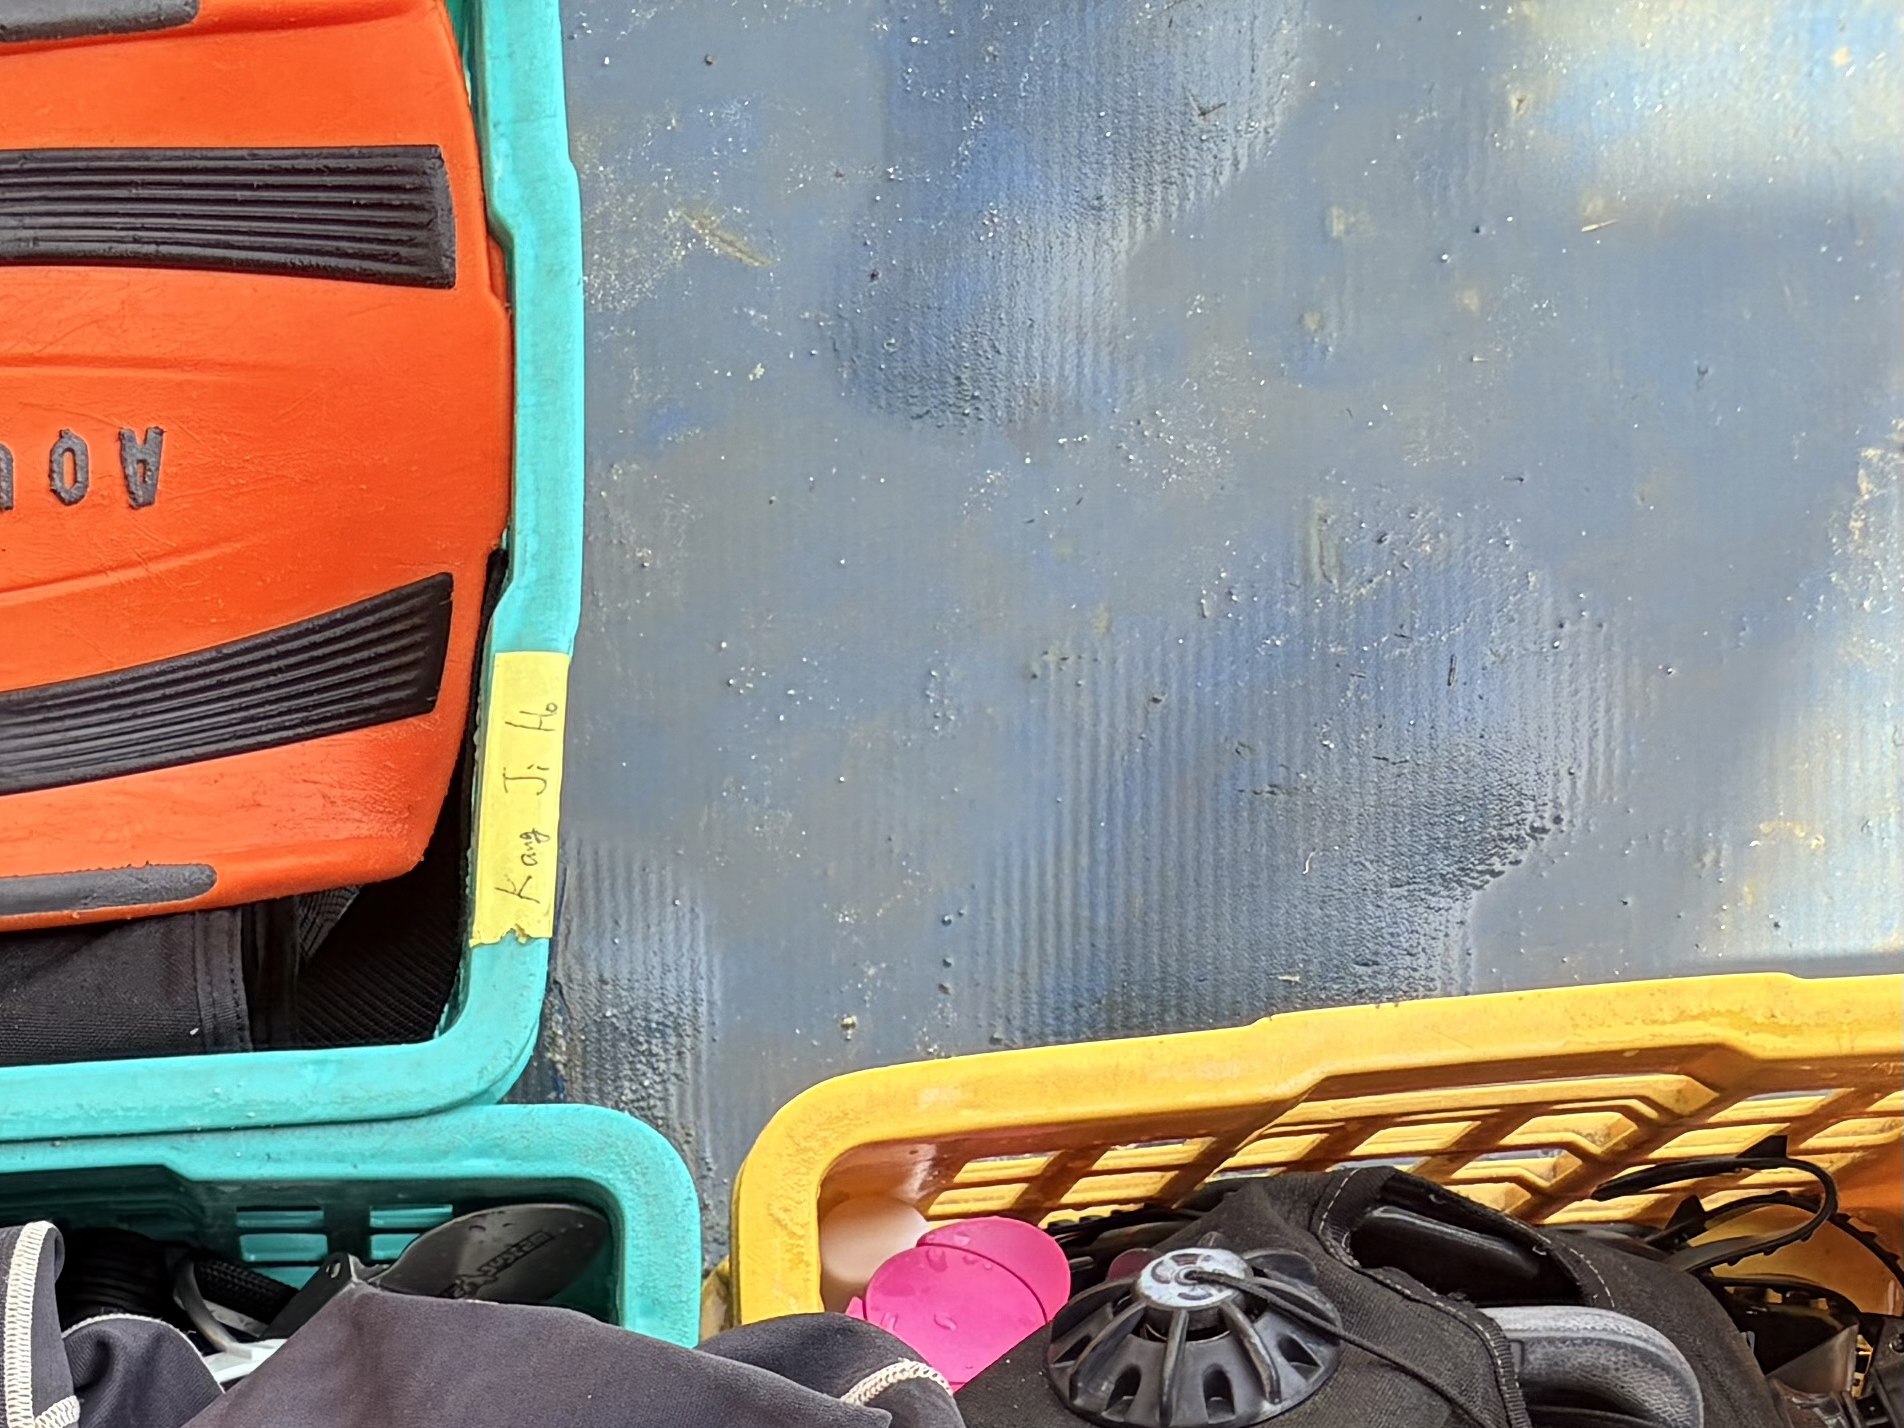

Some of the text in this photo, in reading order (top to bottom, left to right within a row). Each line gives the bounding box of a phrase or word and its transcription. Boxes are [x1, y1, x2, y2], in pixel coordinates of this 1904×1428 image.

[494, 701, 559, 904] Kang Ji Ho
